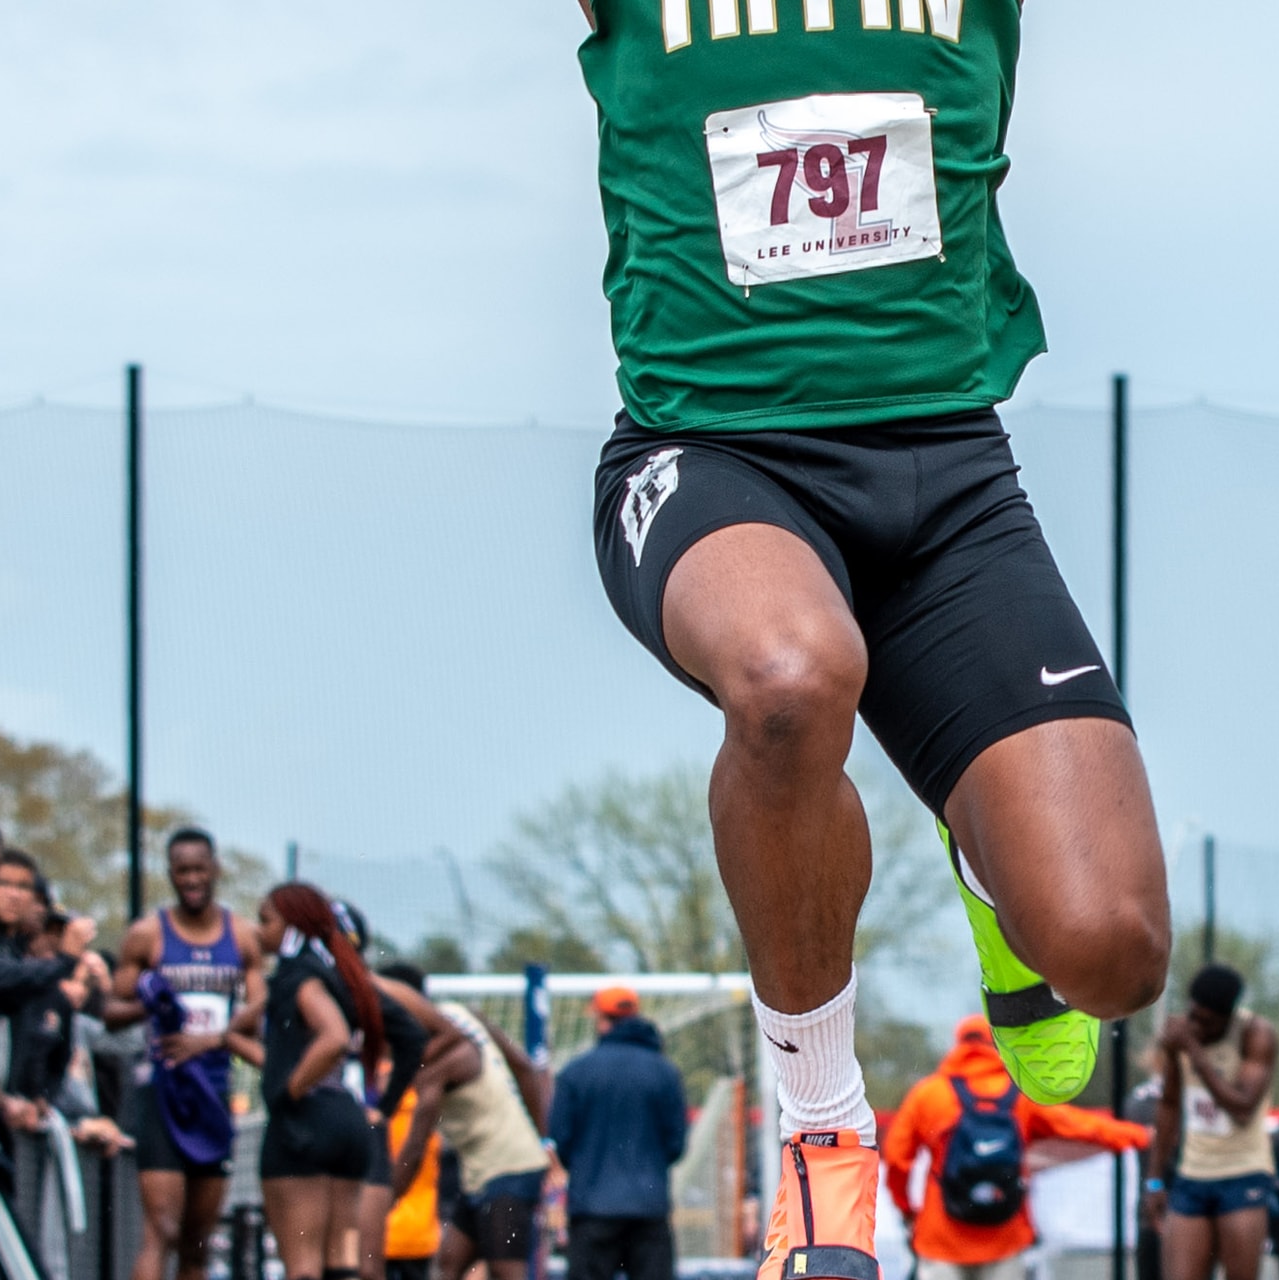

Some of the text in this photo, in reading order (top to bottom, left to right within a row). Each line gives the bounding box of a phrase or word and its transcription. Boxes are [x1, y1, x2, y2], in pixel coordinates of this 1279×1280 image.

[756, 134, 888, 226] 797
[757, 225, 911, 260] LEE UNIVERSITY
[805, 1134, 835, 1147] NIKE
